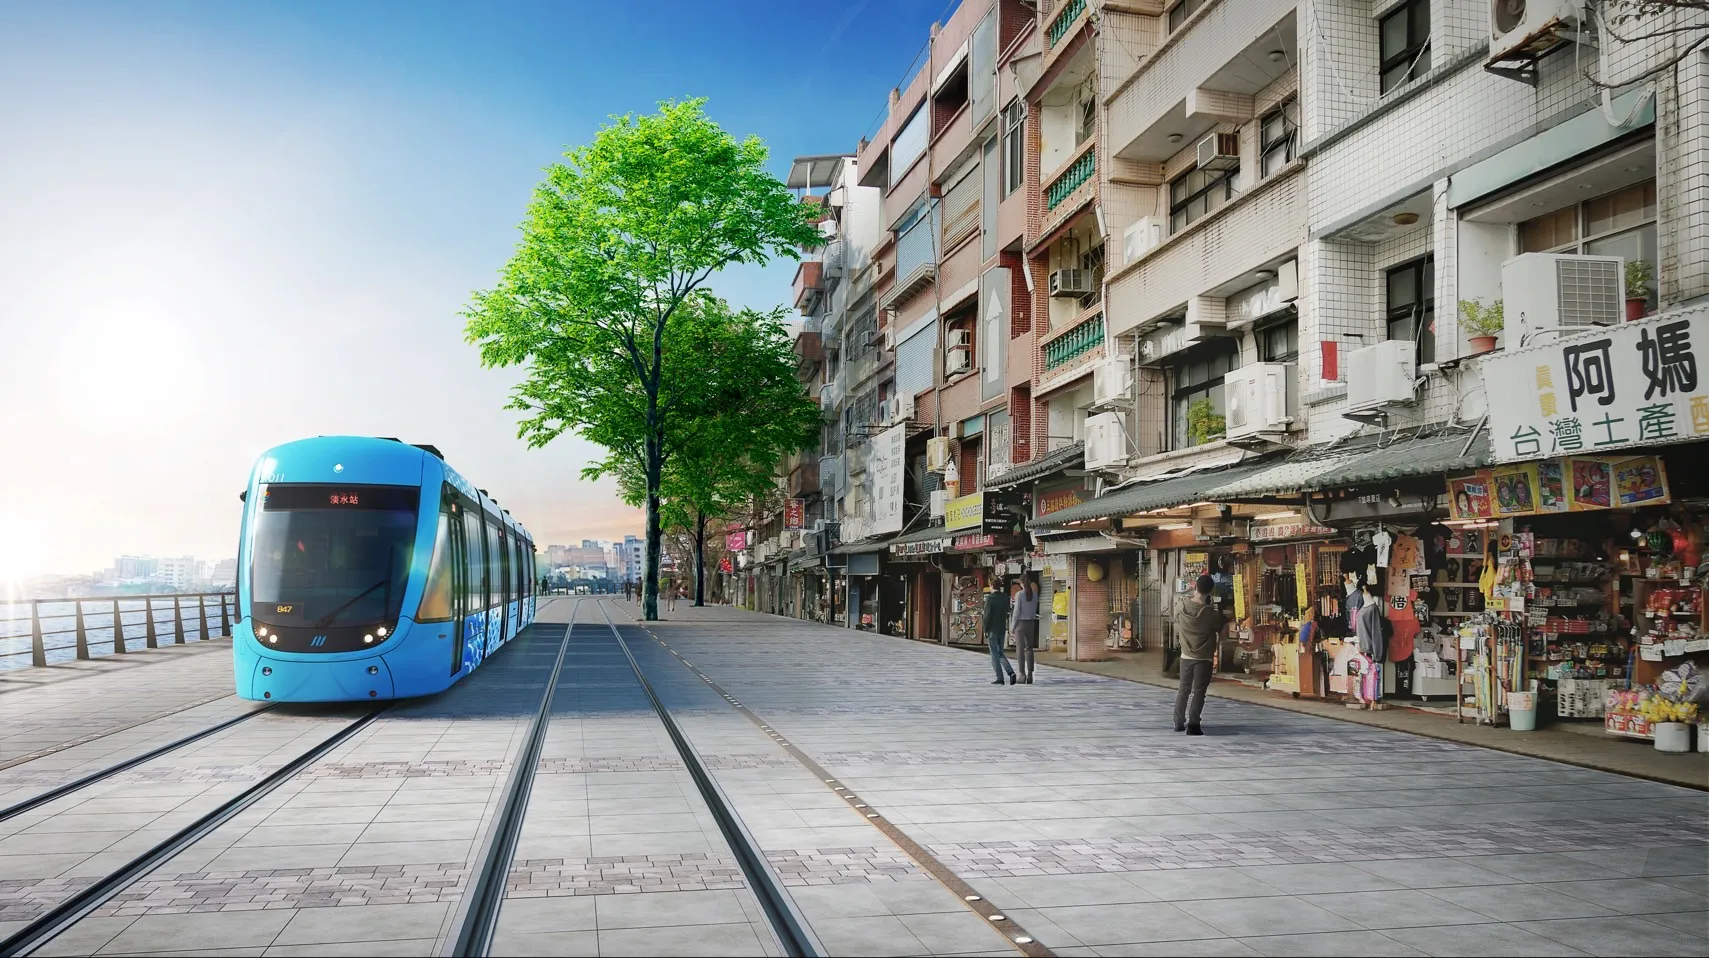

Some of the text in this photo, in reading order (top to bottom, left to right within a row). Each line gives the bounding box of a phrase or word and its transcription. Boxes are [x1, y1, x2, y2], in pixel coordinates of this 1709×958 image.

[1563, 319, 1698, 412] 阿媽
[1510, 402, 1678, 456] 台灣土產
[329, 495, 359, 505] 淡水站
[1391, 595, 1406, 608] 悟
